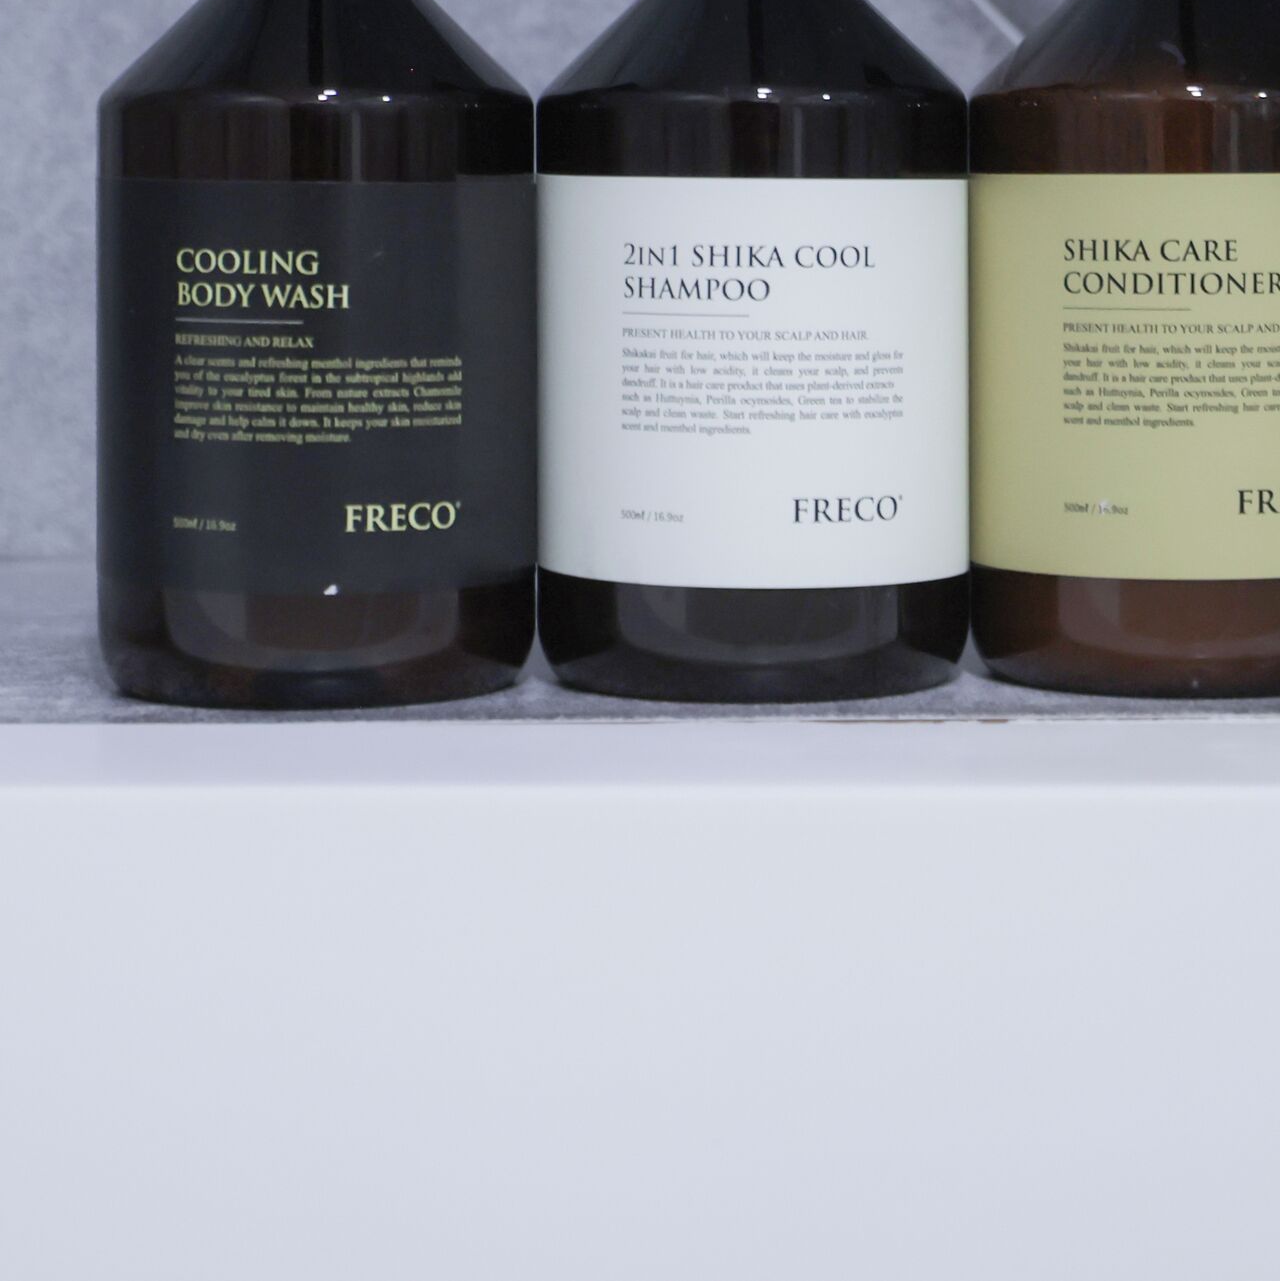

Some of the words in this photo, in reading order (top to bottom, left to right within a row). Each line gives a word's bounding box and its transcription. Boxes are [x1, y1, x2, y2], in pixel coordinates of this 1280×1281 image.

[176, 248, 319, 276] COOLING
[691, 245, 785, 268] SHIKA
[795, 245, 876, 269] COOL
[1063, 238, 1150, 262] SHIKA
[1160, 239, 1238, 262] CARE
[177, 281, 255, 308] BODY
[261, 283, 350, 309] WASH
[623, 275, 771, 302] SHAMPOO
[621, 327, 667, 339] PRESENT
[669, 329, 716, 340] HEALTH
[719, 330, 735, 340] TO
[737, 330, 771, 341] YOUR
[774, 331, 812, 341] SCALP
[813, 331, 839, 341] AND
[840, 330, 868, 341] HAIR
[1062, 323, 1108, 333] PRESENT
[1111, 323, 1158, 334] HEALTH
[1162, 324, 1178, 334] TO
[1179, 324, 1214, 334] YOUR
[1216, 323, 1254, 334] SCALP
[1255, 323, 1280, 333] AND
[175, 334, 242, 347] REFRESHING
[244, 336, 270, 347] AND
[272, 337, 313, 348] RELAX
[719, 351, 748, 361] which
[751, 351, 770, 361] will
[772, 351, 795, 364] keep
[690, 365, 707, 375] low
[726, 380, 763, 393] product
[344, 501, 457, 533] FRECO
[792, 495, 899, 524] FRECO
